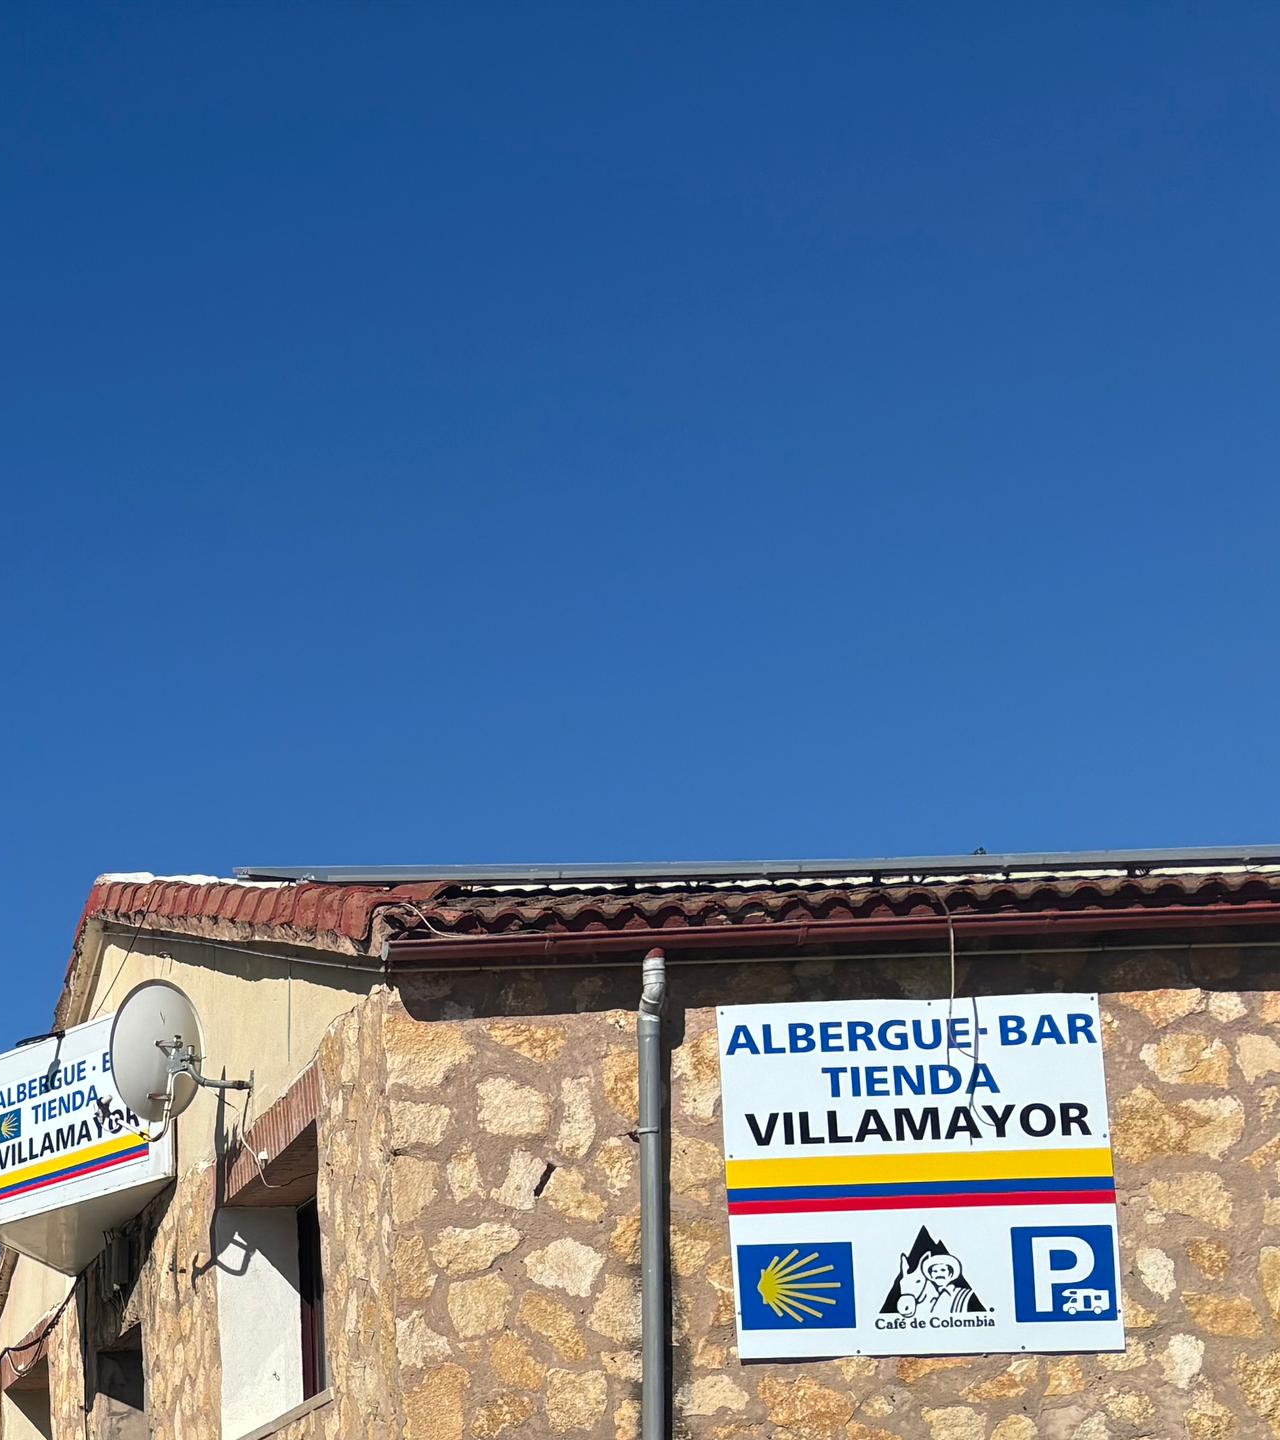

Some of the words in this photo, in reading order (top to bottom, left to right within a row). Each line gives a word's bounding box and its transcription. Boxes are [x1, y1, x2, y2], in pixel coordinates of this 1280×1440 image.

[821, 1063, 1001, 1098] TIENDA
[32, 1085, 98, 1125] TIENDA
[745, 1102, 1093, 1146] VILLAMAYOR
[875, 1315, 907, 1330] Café
[910, 1315, 927, 1329] de
[929, 1315, 996, 1329] Colombia
